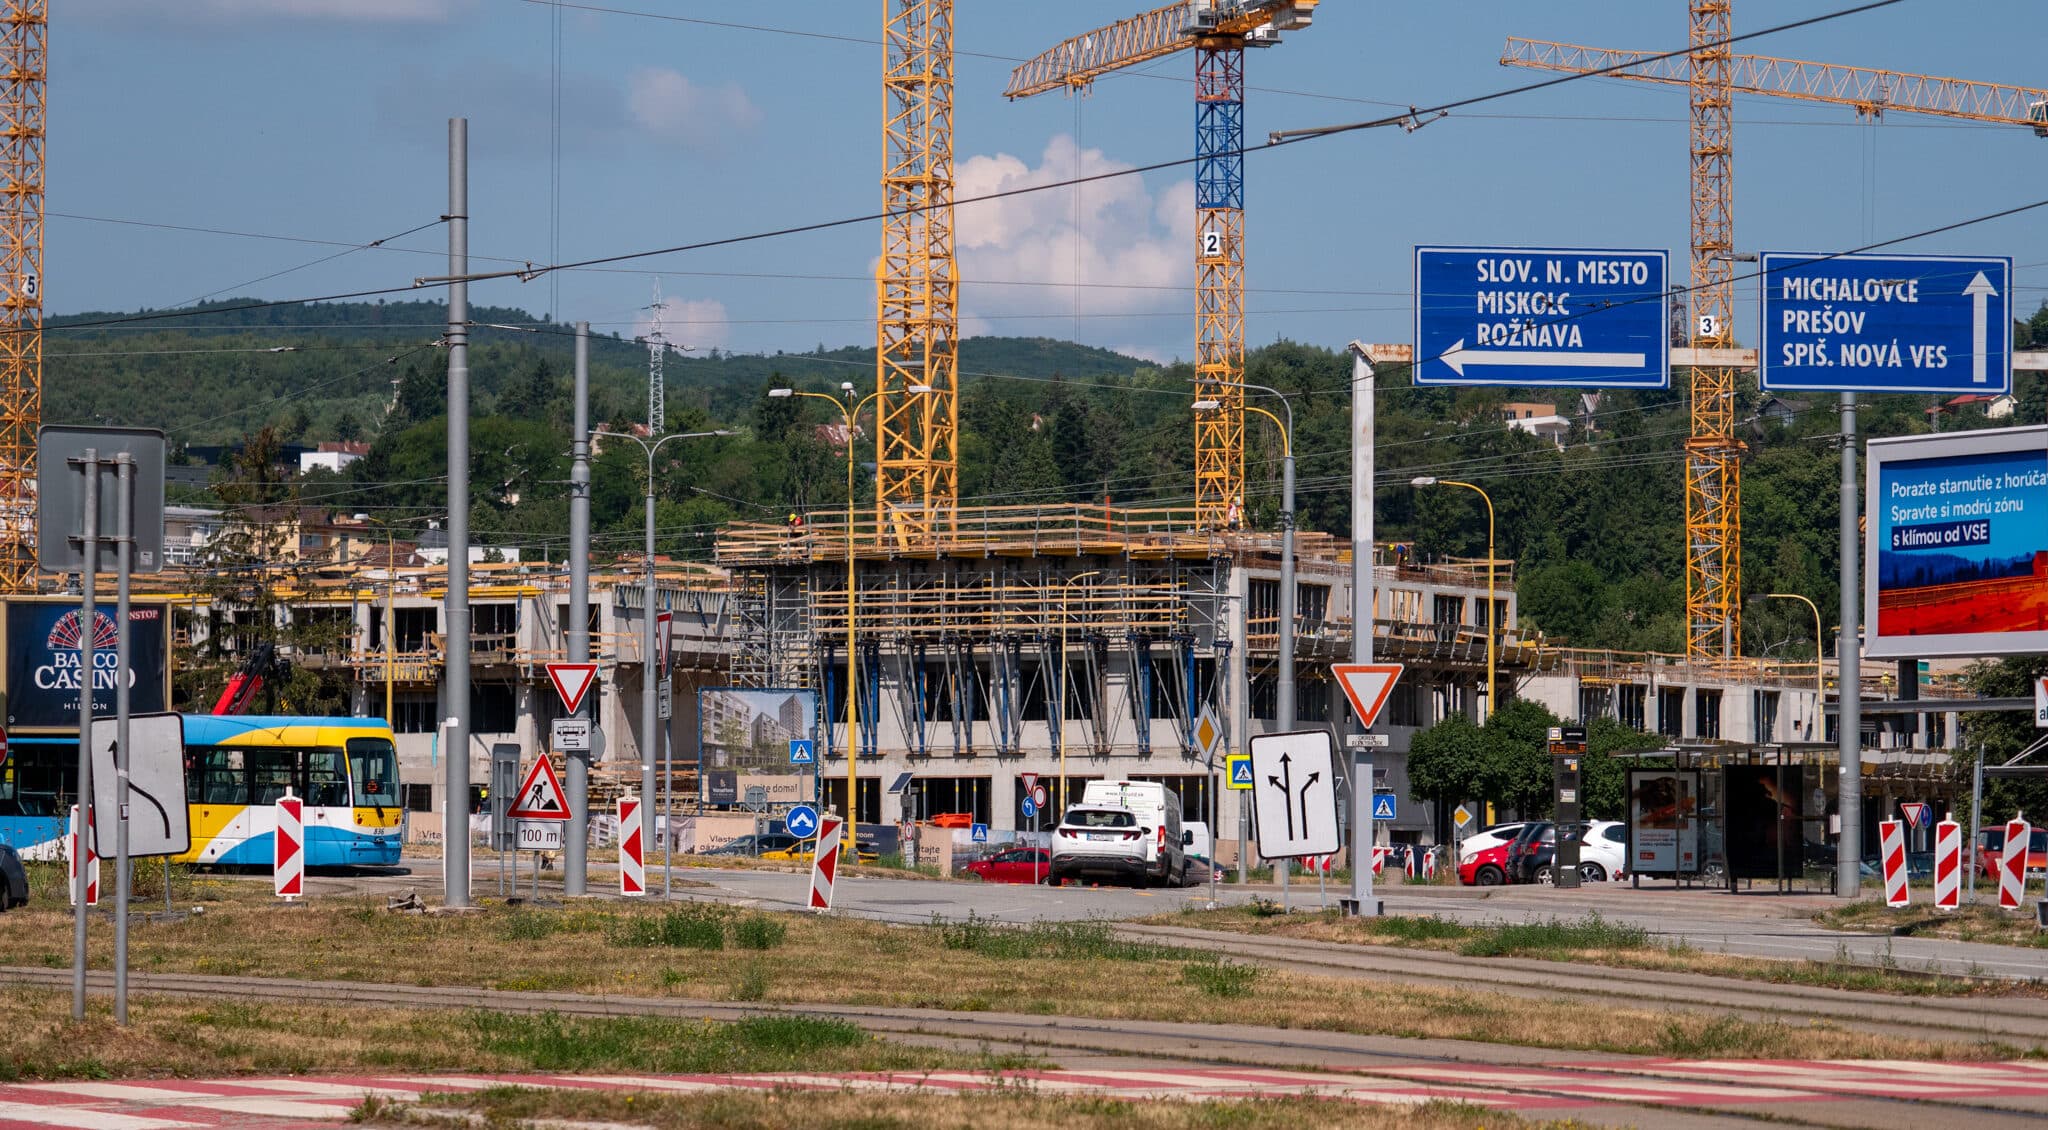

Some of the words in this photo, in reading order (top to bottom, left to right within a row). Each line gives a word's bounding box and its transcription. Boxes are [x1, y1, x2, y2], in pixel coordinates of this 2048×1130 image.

[1207, 234, 1218, 252] 2
[1476, 258, 1539, 284] SLOV.
[1546, 260, 1571, 284] N.
[1577, 260, 1649, 286] MESTO
[27, 274, 36, 294] 5
[1782, 277, 1919, 303] MICHALOVCE
[1476, 290, 1570, 316] MISKOLC
[1702, 317, 1713, 334] 3
[1782, 304, 1866, 335] PREŠOV
[1782, 337, 1835, 368] SPIŠ.
[1840, 338, 1902, 368] NOVÁ
[1909, 344, 1948, 369] VES
[1891, 481, 1937, 498] Porazte
[1939, 474, 1993, 494] starnutie
[1995, 477, 2001, 489] z
[2004, 469, 2048, 489] horúča
[1891, 504, 1937, 524] Spravte
[1940, 501, 1950, 518] si
[1952, 498, 1992, 516] modrú
[1994, 496, 2024, 513] zónu
[1893, 534, 1900, 547] s
[1902, 528, 1942, 546] klímou
[1944, 525, 1960, 542] od
[1962, 523, 1988, 541] VSE
[53, 652, 118, 669] BACO
[743, 783, 771, 793] Vite
[773, 783, 798, 793] doma!
[422, 830, 442, 839] Vita
[521, 829, 542, 842] 100
[546, 832, 557, 842] m
[840, 831, 874, 839] shroom
